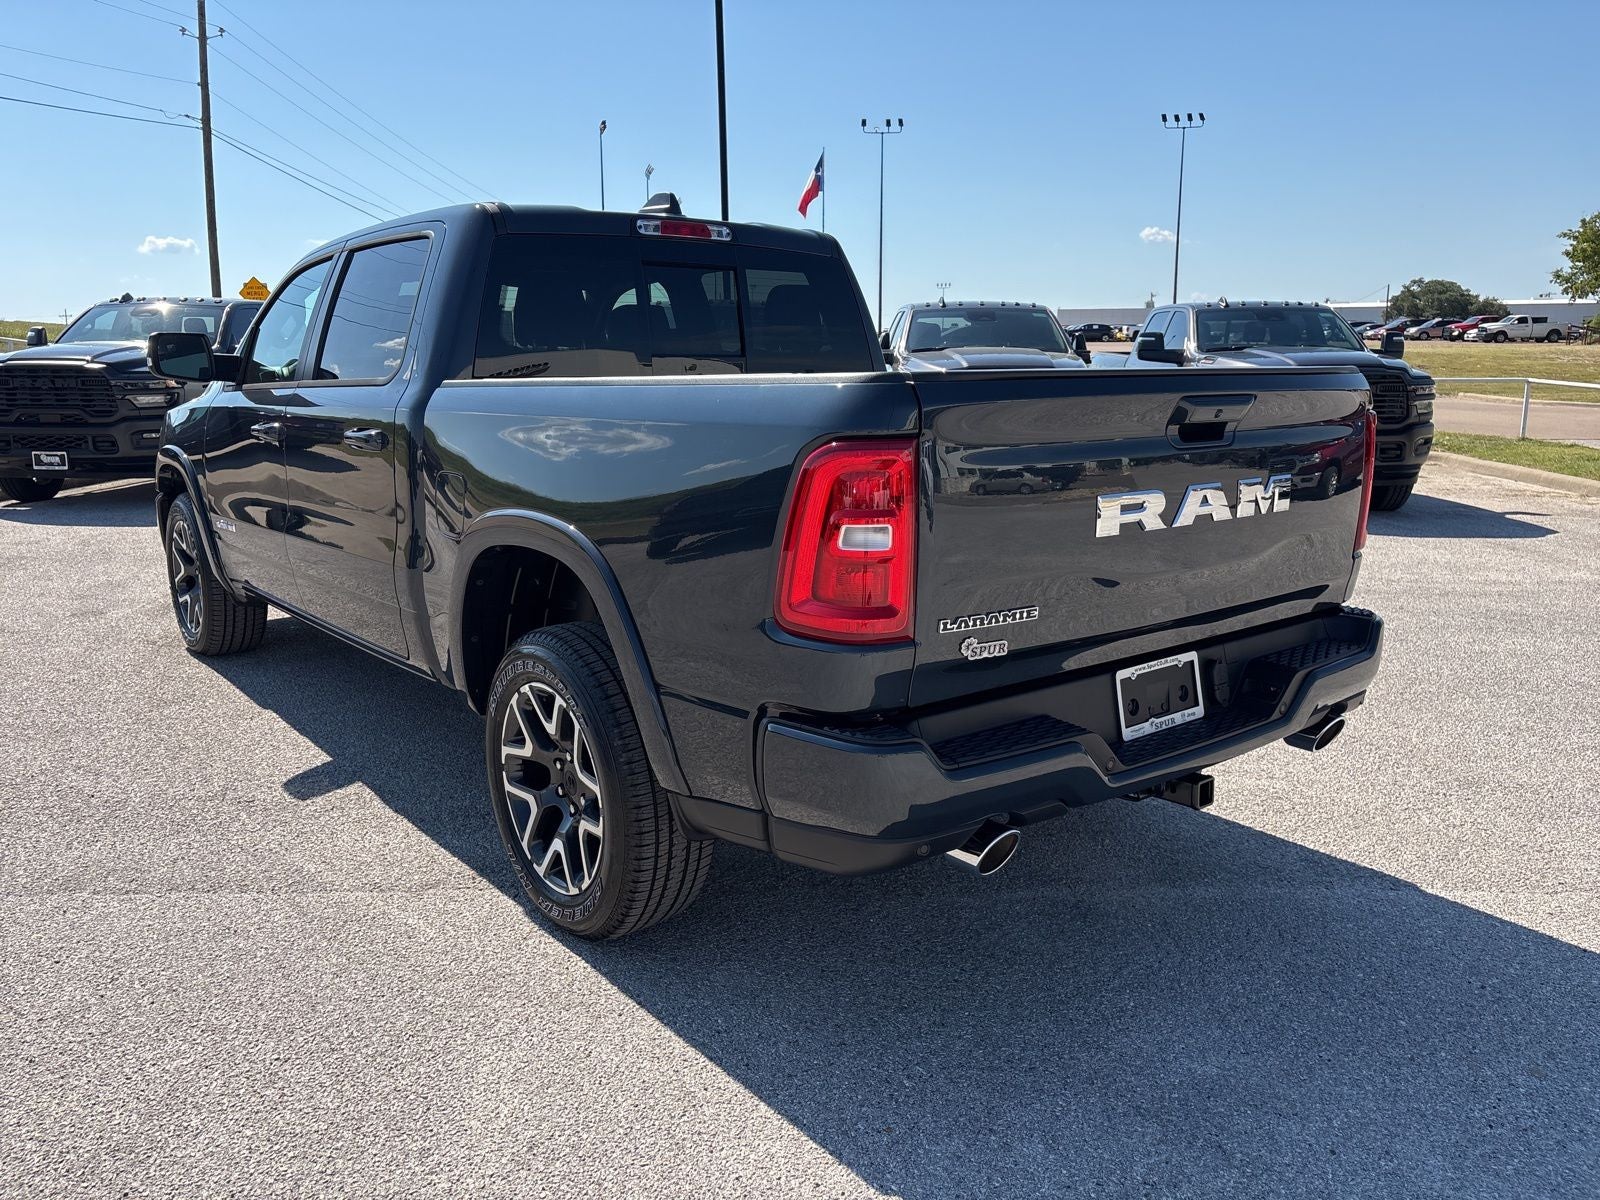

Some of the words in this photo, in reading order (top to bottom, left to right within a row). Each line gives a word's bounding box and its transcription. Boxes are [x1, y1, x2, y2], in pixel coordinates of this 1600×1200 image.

[1095, 473, 1292, 538] RAM
[939, 606, 1039, 633] LARAMIE
[970, 641, 1008, 658] SPUR
[489, 660, 587, 729] BRIDGESTONE
[1154, 717, 1176, 730] SPUR
[538, 876, 603, 921] DUELER
